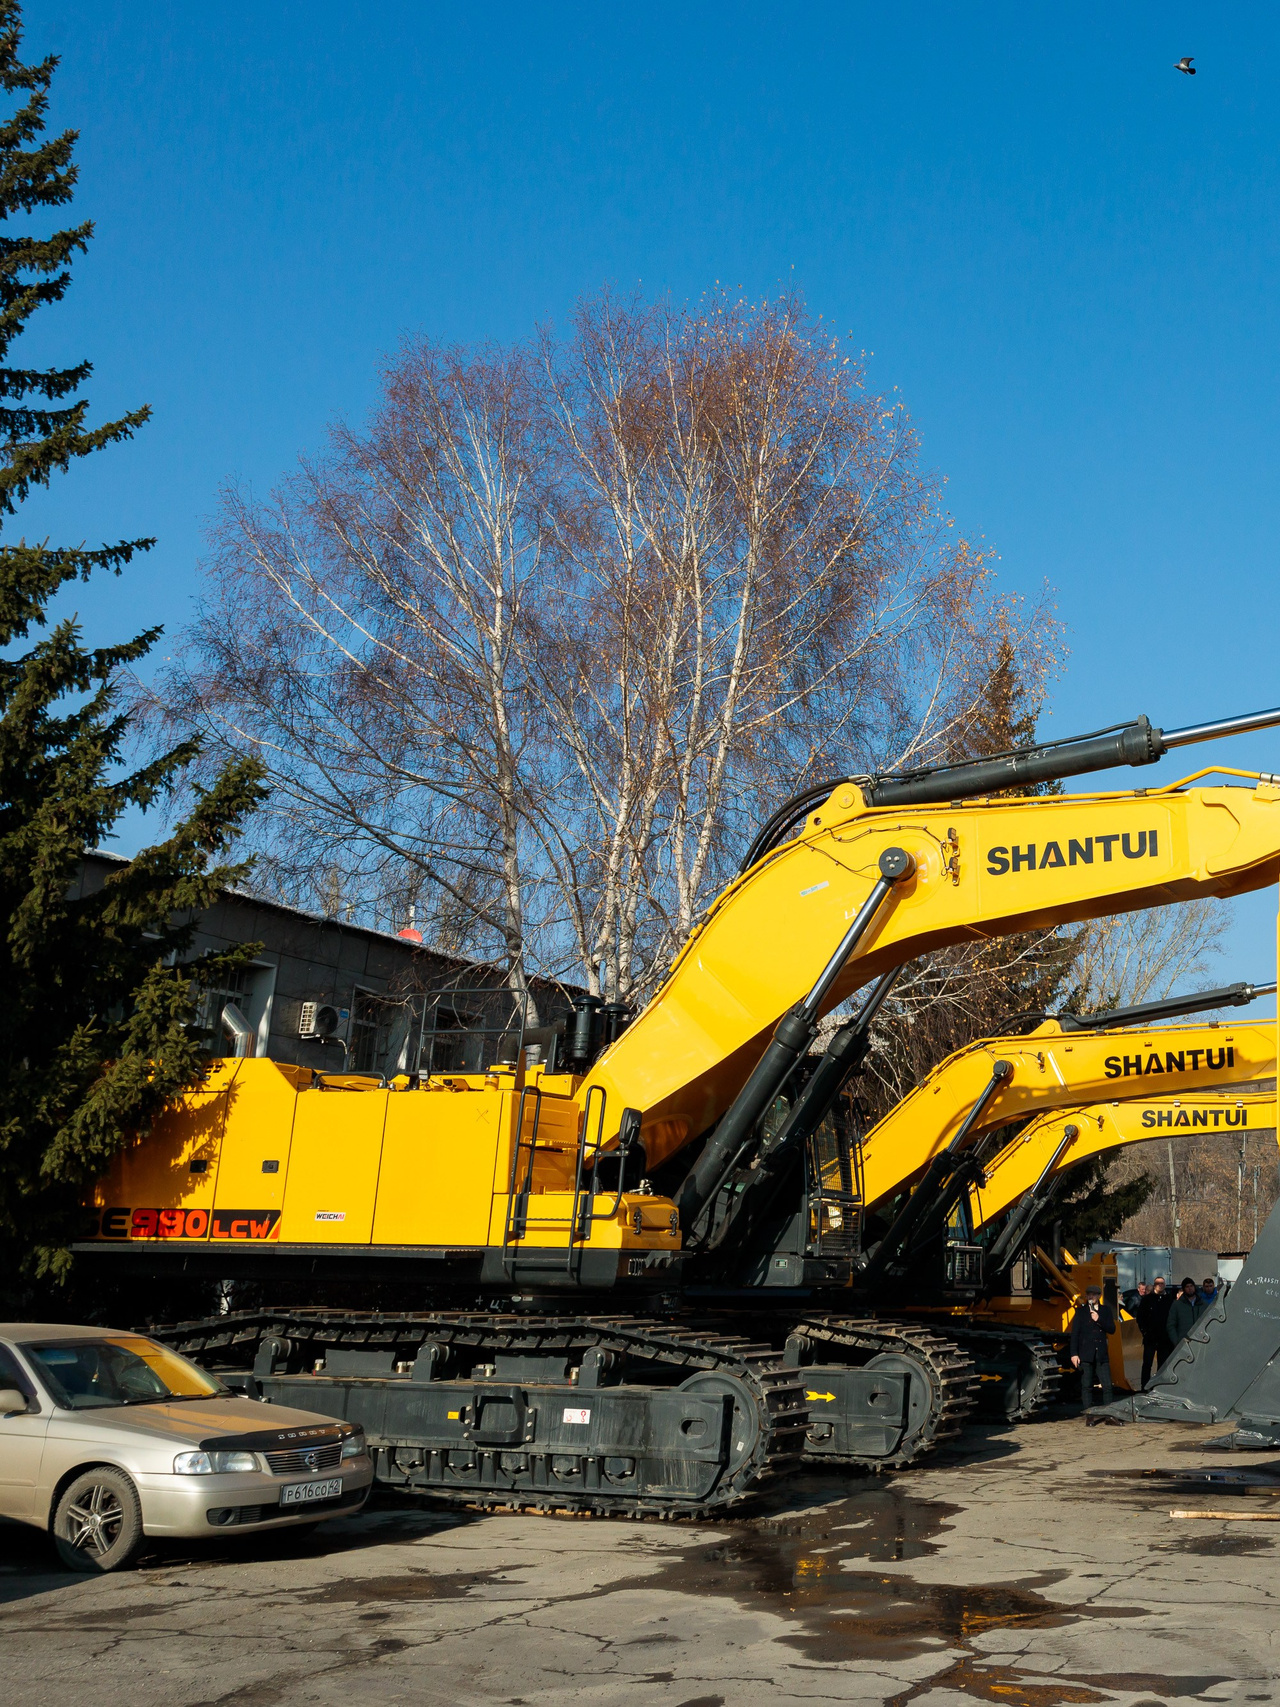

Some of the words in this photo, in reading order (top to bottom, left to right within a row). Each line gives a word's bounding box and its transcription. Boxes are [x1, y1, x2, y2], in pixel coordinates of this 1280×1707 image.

[986, 829, 1159, 876] SHANTUI
[1104, 1046, 1234, 1079] SHANTUI
[1141, 1109, 1248, 1128] SHANTUI
[213, 1219, 271, 1239] LCW
